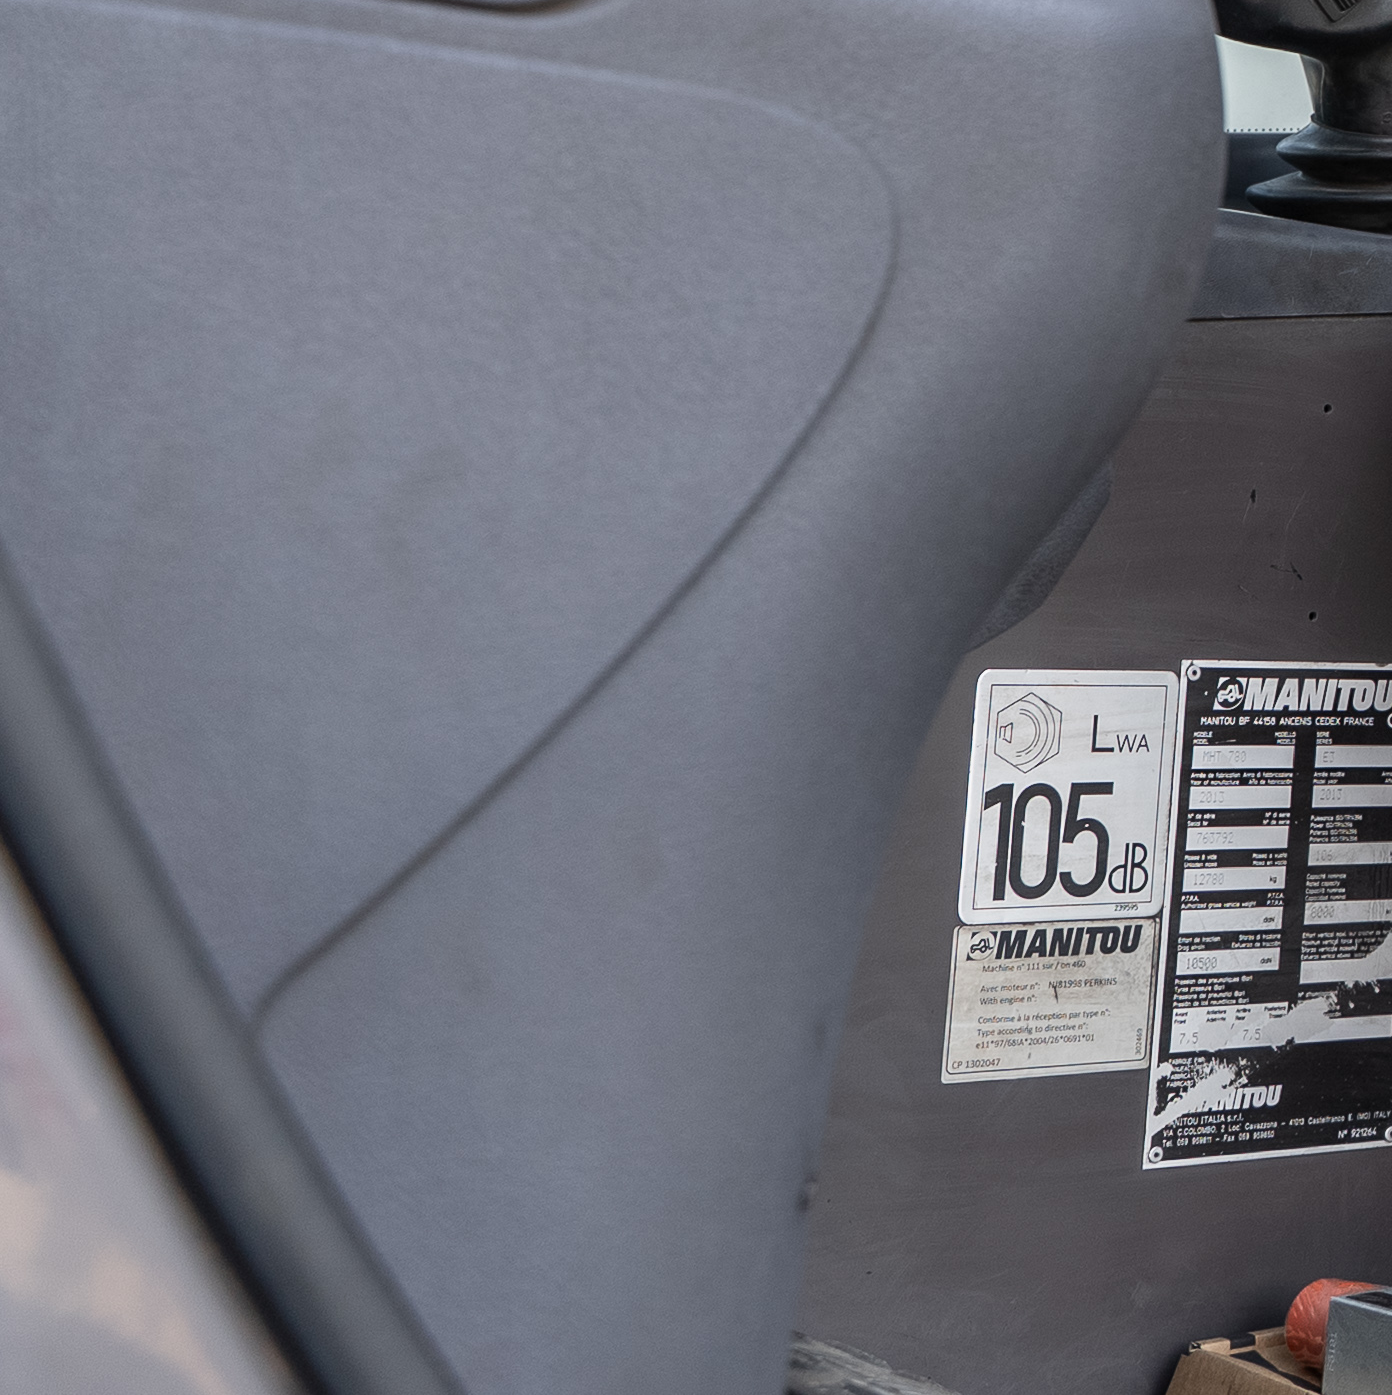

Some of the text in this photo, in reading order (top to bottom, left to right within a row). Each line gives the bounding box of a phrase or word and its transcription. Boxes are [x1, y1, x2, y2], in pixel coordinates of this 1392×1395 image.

[1201, 716, 1374, 726] MANITOU BF 44158 ANCENIS CEDEX FRANCE
[1202, 750, 1221, 762] MHT
[1200, 791, 1224, 803] 2013
[1320, 788, 1342, 800] 2013
[984, 782, 1114, 901] 105
[1196, 832, 1234, 844] 763792
[1108, 843, 1148, 893] dB
[1194, 873, 1278, 886] 12780 kg
[995, 925, 1143, 959] MANITOU
[982, 963, 1014, 973] Machine
[1027, 962, 1040, 971] 111
[1186, 956, 1218, 970] 10500
[980, 985, 998, 993] Avec
[1000, 984, 1029, 992] moteur
[1084, 978, 1117, 987] PERKINS
[980, 997, 998, 1005] With
[1000, 996, 1025, 1005] engine
[978, 1015, 1015, 1024] Conforme
[1017, 1014, 1022, 1022] à
[1024, 1013, 1030, 1021] la
[1032, 1010, 1067, 1022] réception
[1069, 1011, 1081, 1020] par
[1083, 1010, 1099, 1019] type
[977, 1028, 995, 1037] Type
[997, 1025, 1033, 1036] according
[1045, 1023, 1076, 1032] directive
[1242, 1028, 1261, 1040] 7,5
[1180, 1032, 1198, 1045] 7,5
[965, 1058, 1001, 1068] 1302047
[1163, 1129, 1173, 1137] VIA
[1308, 1116, 1345, 1124] Castelfranco
[1374, 1110, 1391, 1118] ITALY
[1200, 1115, 1226, 1125] ITALIA
[1227, 1114, 1244, 1122] s.r.l.
[1223, 1134, 1234, 1142] Fax
[1351, 1128, 1376, 1138] 921264
